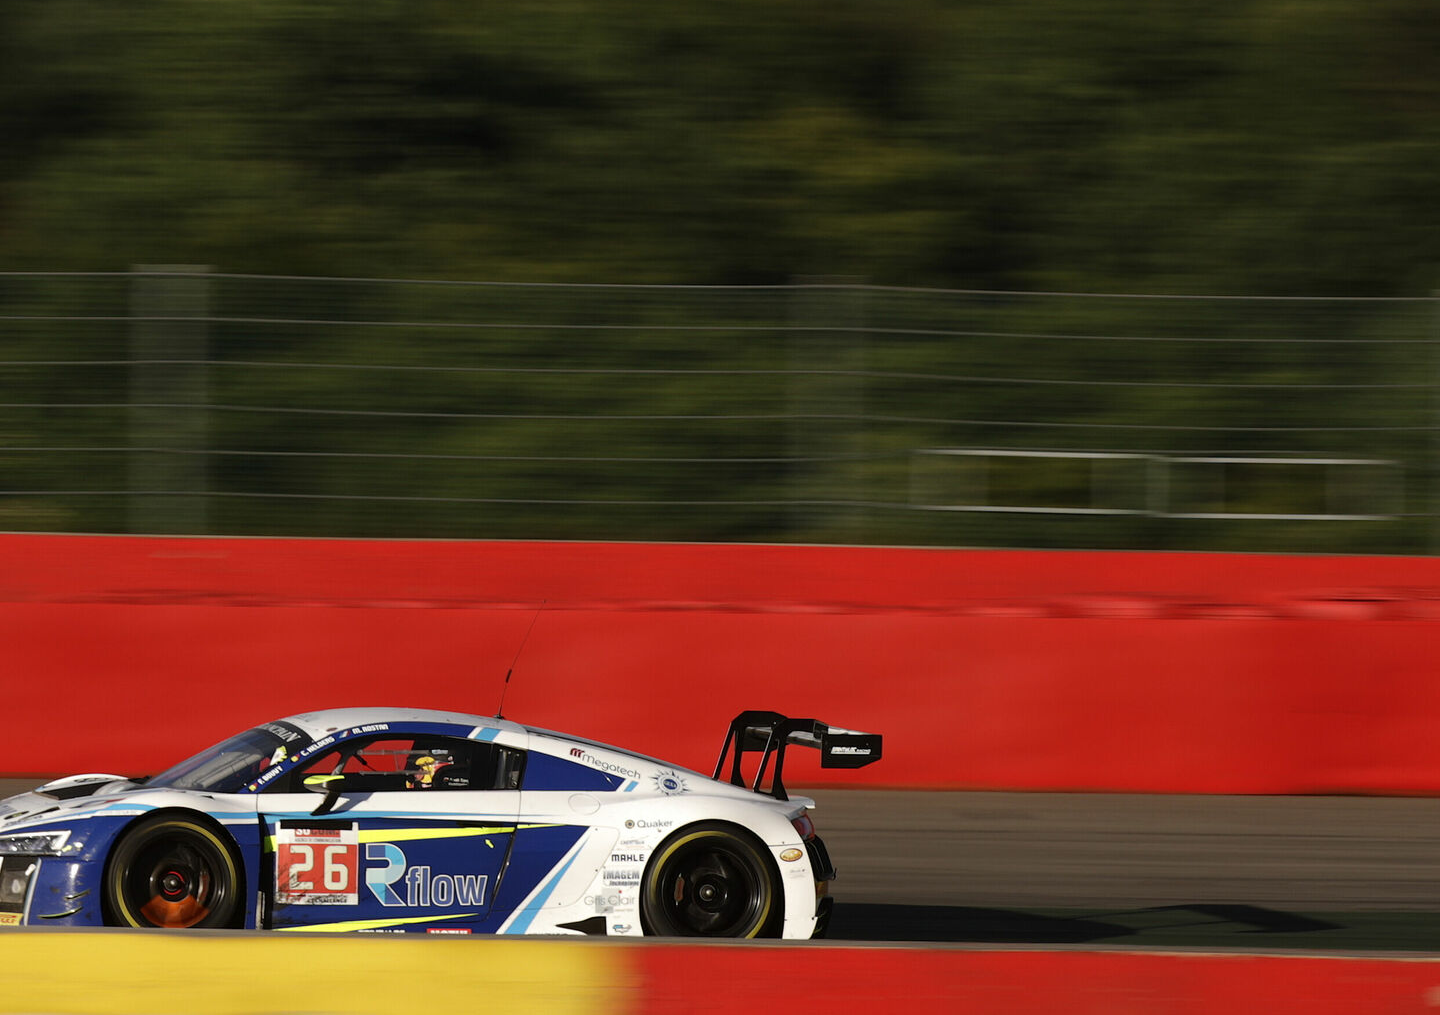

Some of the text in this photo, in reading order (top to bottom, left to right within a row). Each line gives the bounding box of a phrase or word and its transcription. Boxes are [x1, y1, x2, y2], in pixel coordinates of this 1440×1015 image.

[637, 819, 673, 829] Quaker
[611, 853, 645, 862] MAHLE
[288, 845, 349, 891] 26
